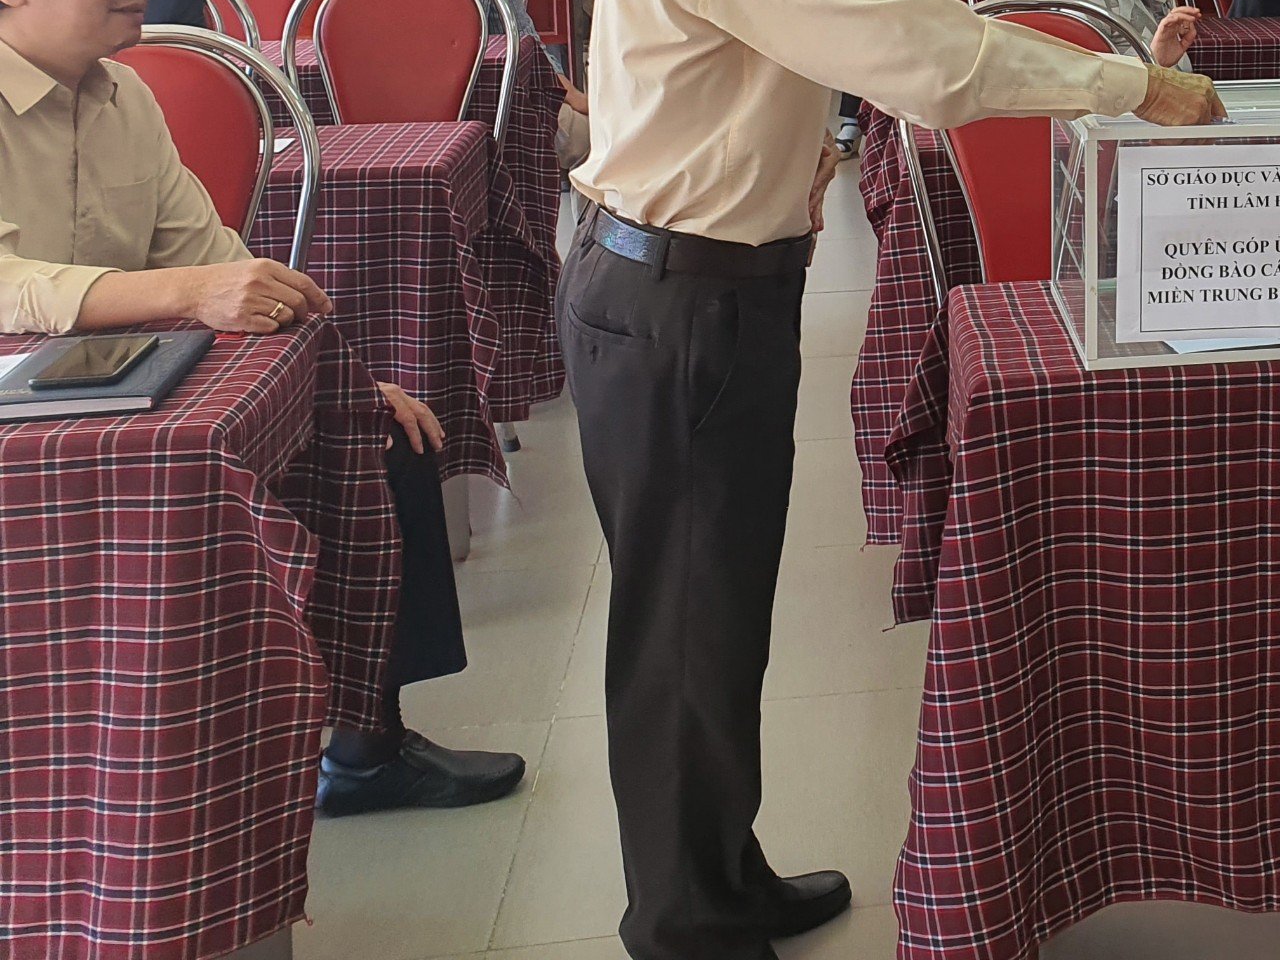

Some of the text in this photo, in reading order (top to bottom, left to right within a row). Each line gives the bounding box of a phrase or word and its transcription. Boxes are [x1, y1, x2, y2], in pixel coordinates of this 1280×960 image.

[1147, 170, 1169, 186] SỞ
[1173, 169, 1217, 185] GIÁO
[1222, 171, 1256, 187] DỤC
[1187, 193, 1228, 210] TỈNH
[1233, 192, 1270, 208] LÂM
[1164, 238, 1227, 259] QUYÊN
[1232, 236, 1269, 254] GÓP
[1219, 260, 1256, 278] BÀO
[1200, 287, 1262, 302] TRUNG
